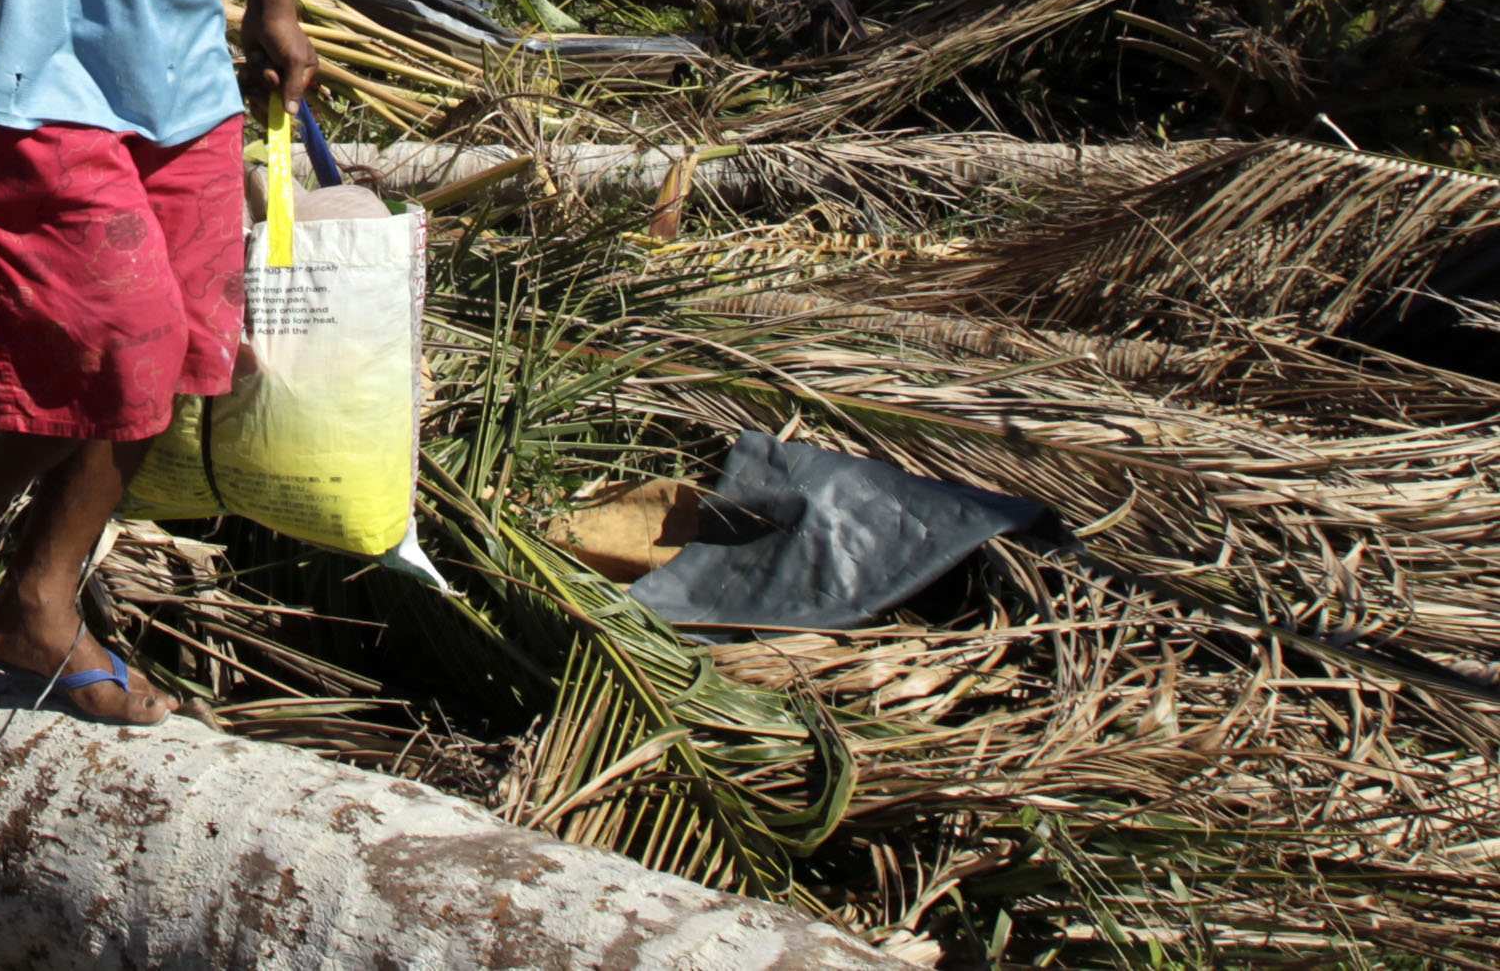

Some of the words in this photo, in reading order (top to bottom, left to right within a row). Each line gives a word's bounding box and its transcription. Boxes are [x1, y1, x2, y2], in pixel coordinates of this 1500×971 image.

[285, 285, 304, 294] and
[263, 295, 285, 304] from
[280, 306, 308, 314] onion
[309, 306, 329, 314] and
[280, 317, 290, 325] to
[292, 316, 311, 325] low
[257, 327, 276, 335] Add
[278, 327, 290, 335] all
[292, 327, 309, 335] the
